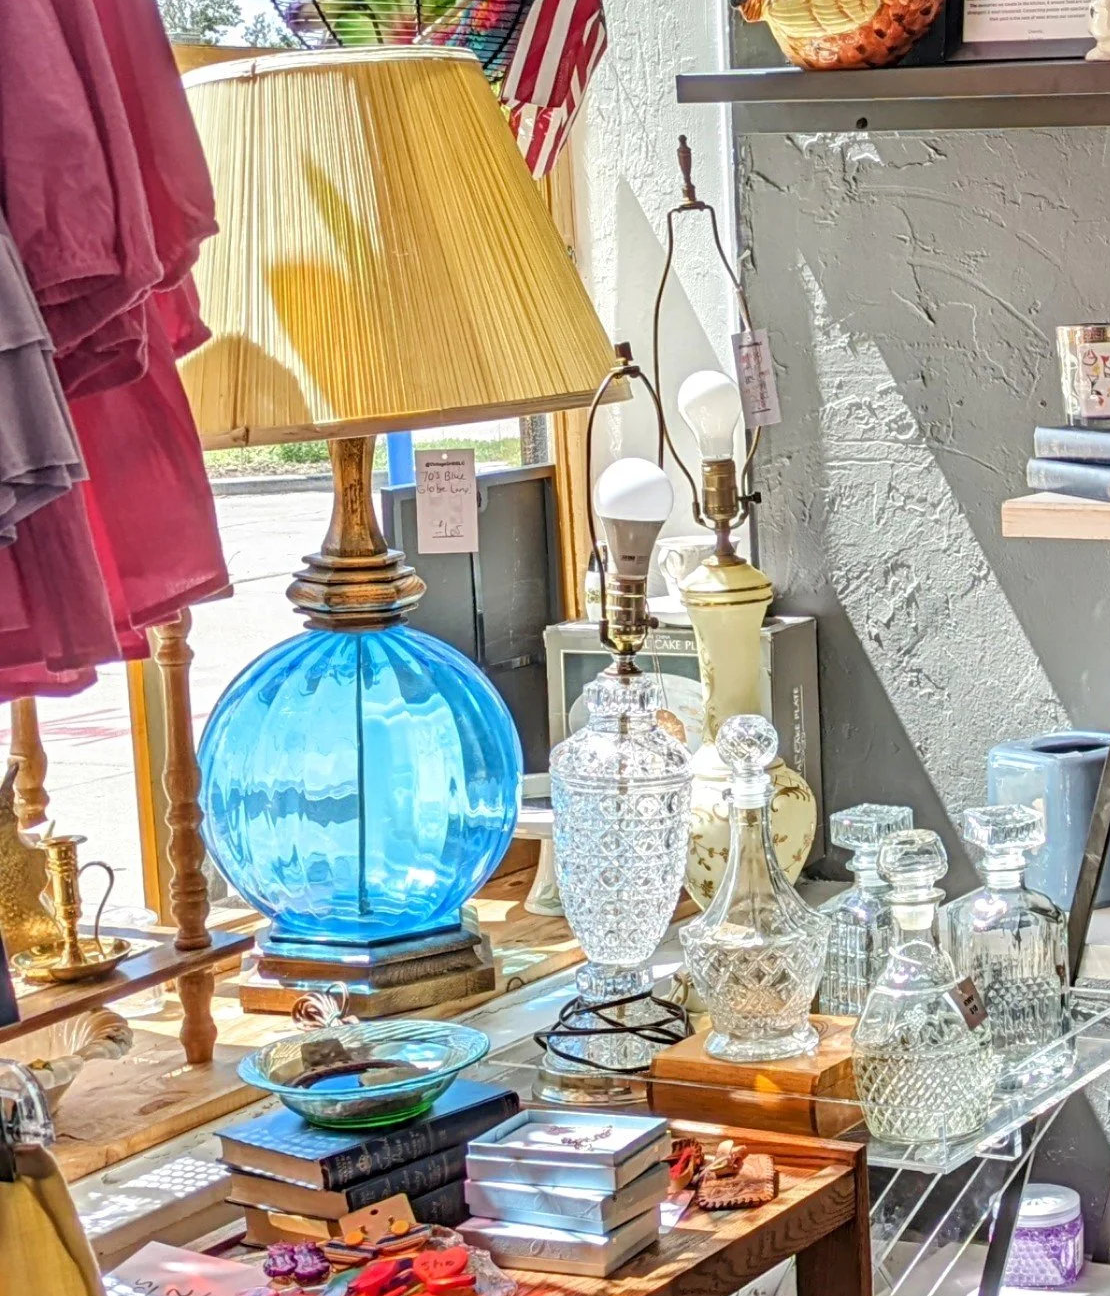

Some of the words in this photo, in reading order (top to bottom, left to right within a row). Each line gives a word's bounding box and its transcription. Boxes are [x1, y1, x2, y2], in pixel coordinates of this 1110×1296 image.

[444, 470, 467, 482] Blue
[655, 639, 681, 650] CAKE
[792, 686, 801, 720] PLATE
